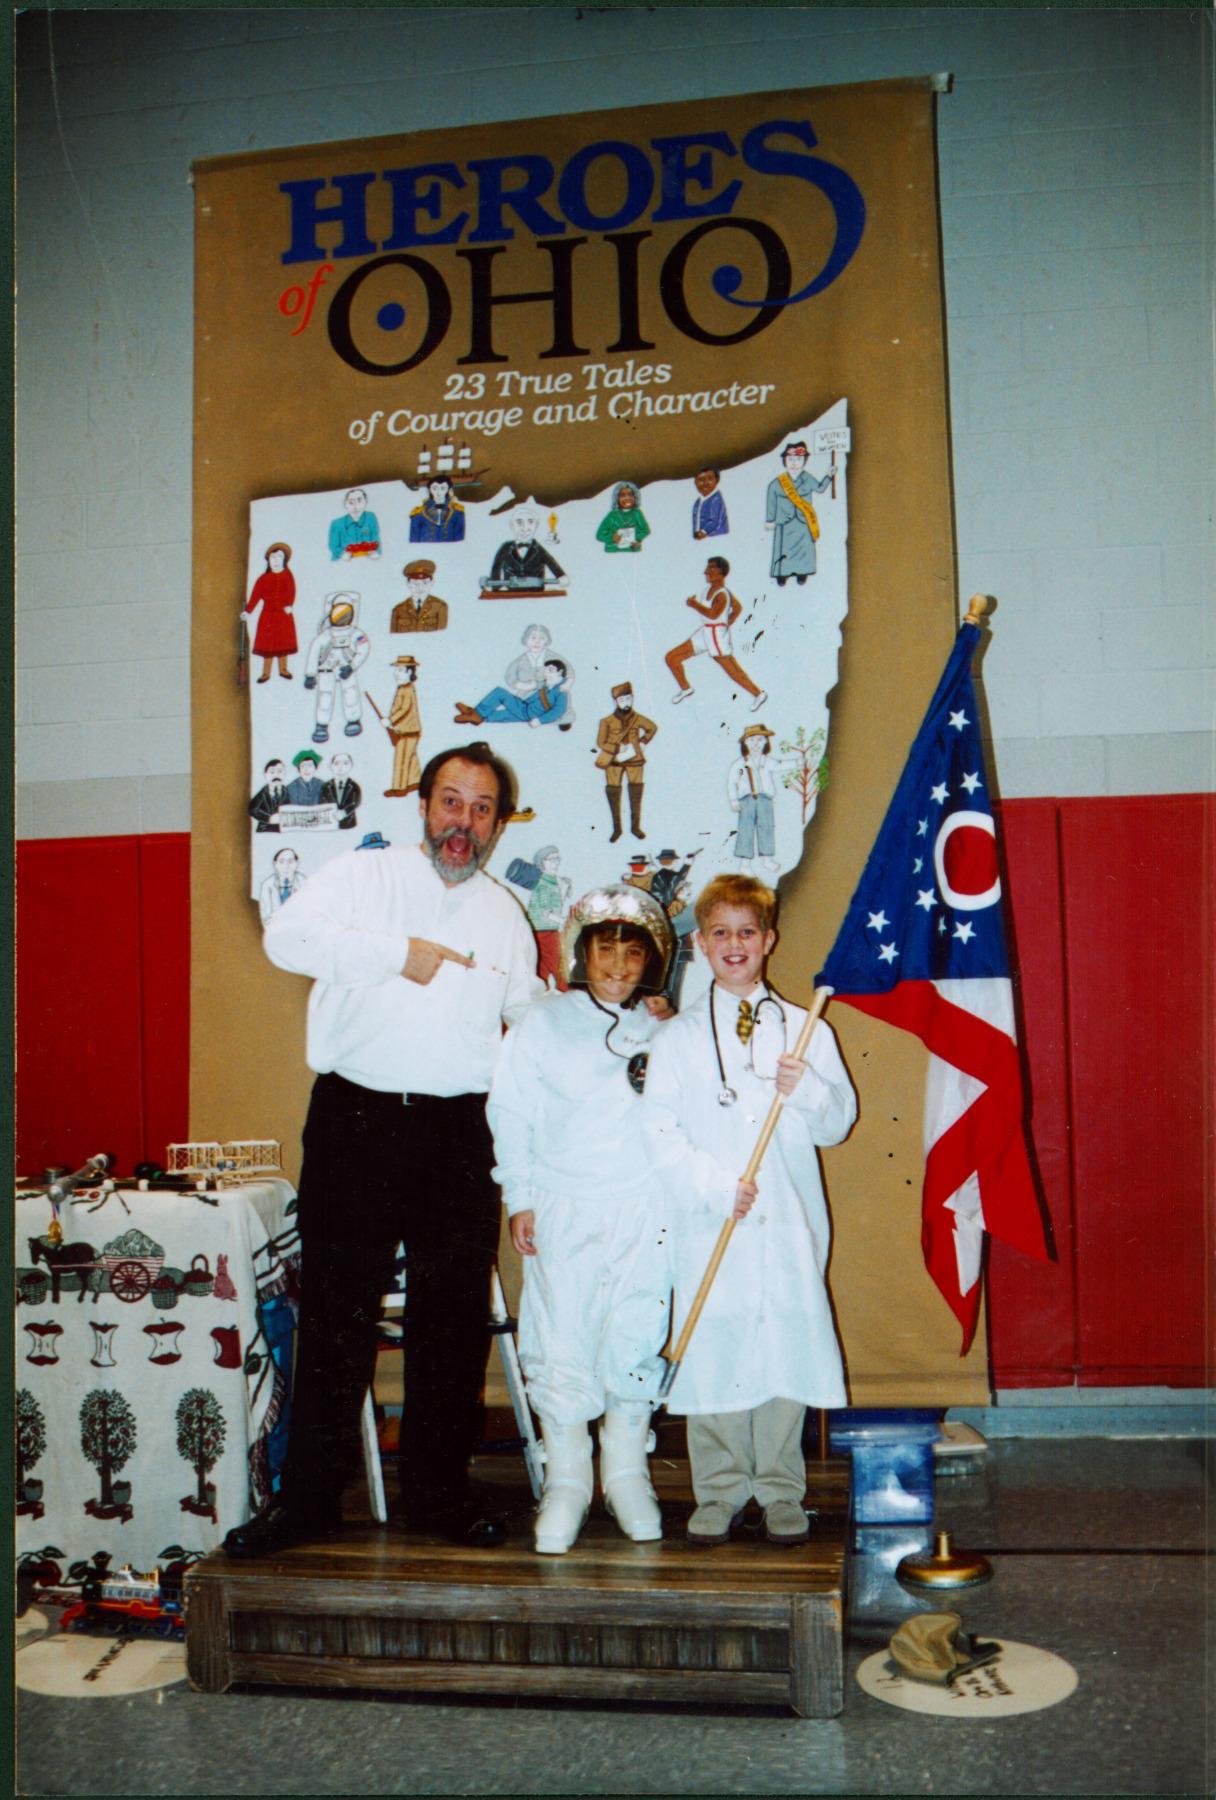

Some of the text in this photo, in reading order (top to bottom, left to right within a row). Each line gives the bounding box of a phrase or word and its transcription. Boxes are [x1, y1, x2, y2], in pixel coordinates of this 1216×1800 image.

[279, 120, 866, 307] HEROES
[278, 216, 793, 376] of OHIO
[348, 381, 776, 445] of Courage and Character
[443, 359, 673, 400] 23 True Tales
